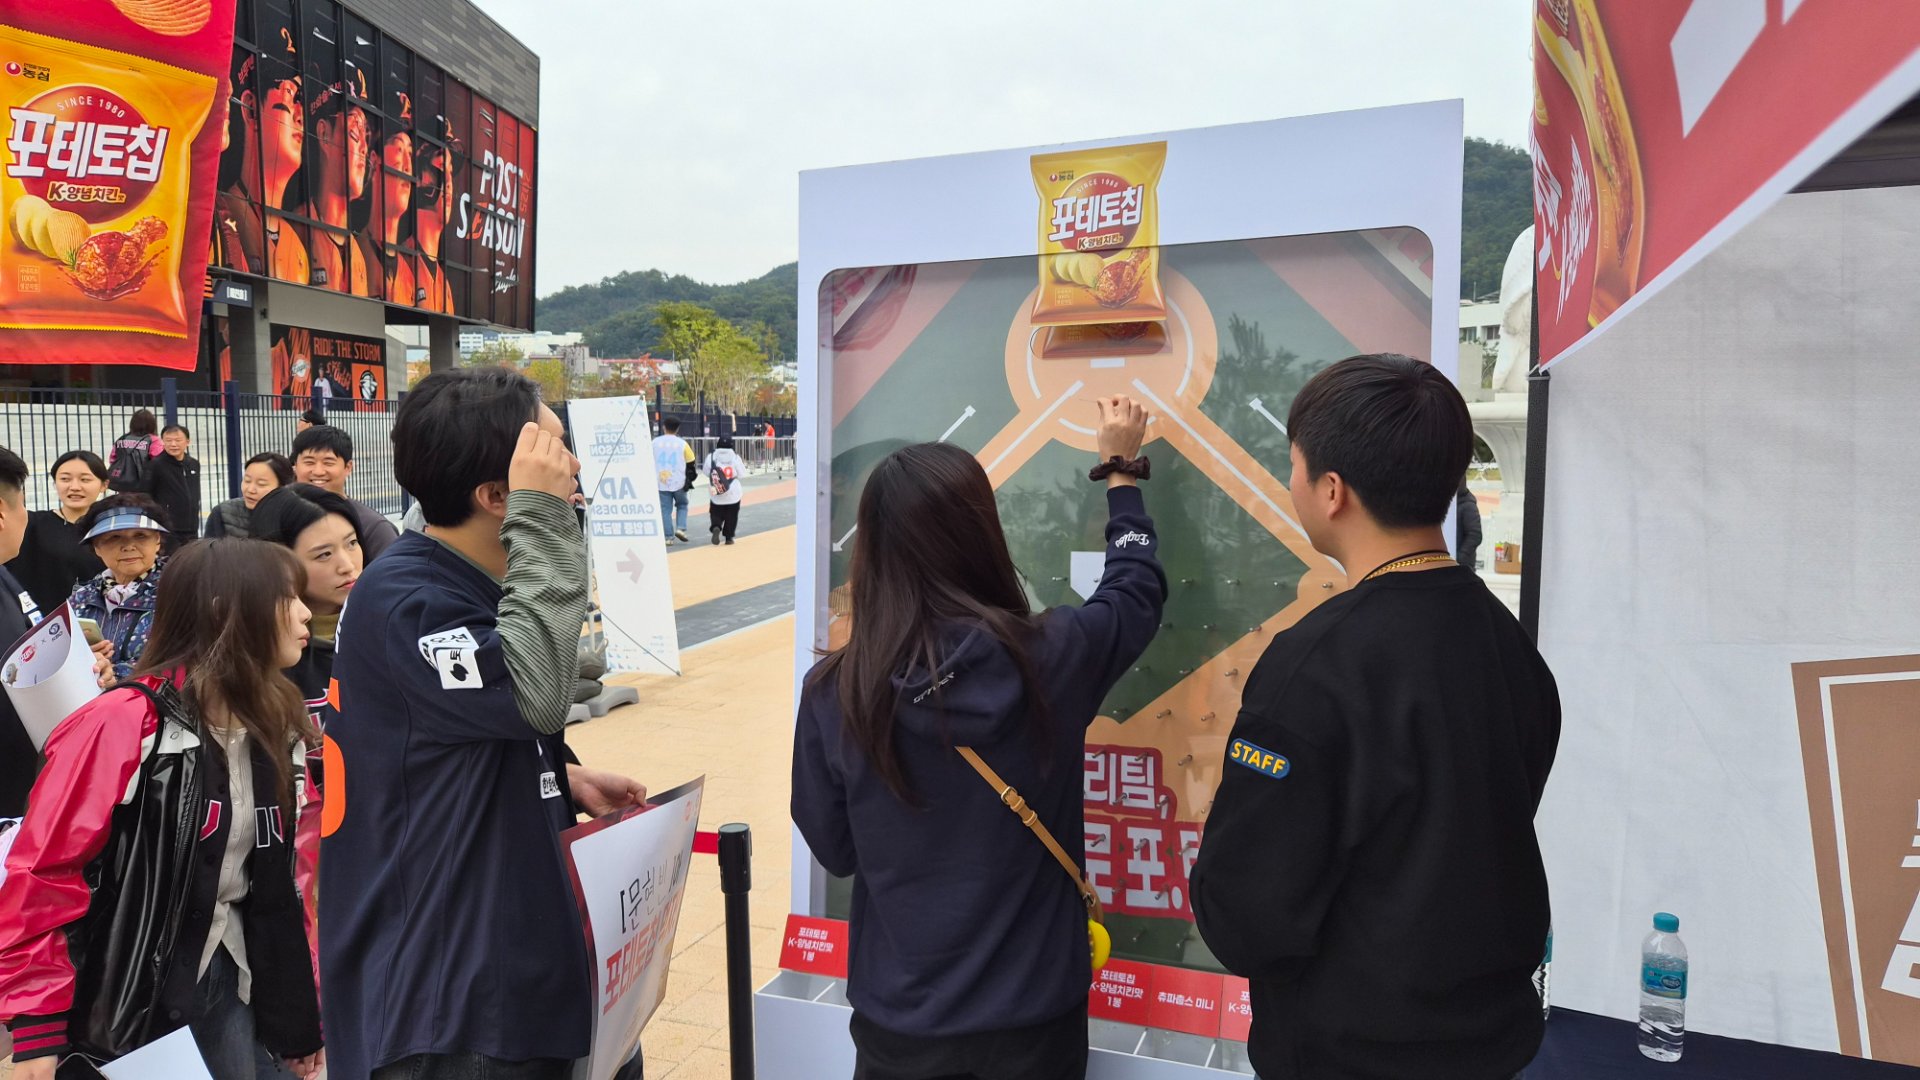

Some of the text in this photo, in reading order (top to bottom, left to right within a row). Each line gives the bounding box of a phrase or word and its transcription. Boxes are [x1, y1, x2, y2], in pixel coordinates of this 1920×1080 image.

[22, 67, 50, 82] 농심
[56, 95, 126, 119] SINCE 1980
[6, 107, 170, 182] 포테토칩
[479, 149, 523, 209] POST
[1076, 178, 1119, 193] SINCE 1980
[1047, 184, 1144, 242] 포테토칩
[456, 192, 526, 260] SEASON
[313, 336, 381, 362] RIDE THE STORM
[1115, 531, 1149, 548] Eagles
[1231, 742, 1286, 774] STAFF
[1100, 969, 1136, 985] 포테토칩
[1090, 981, 1144, 999] K-양념치킨맛
[1195, 997, 1214, 1011] 미니
